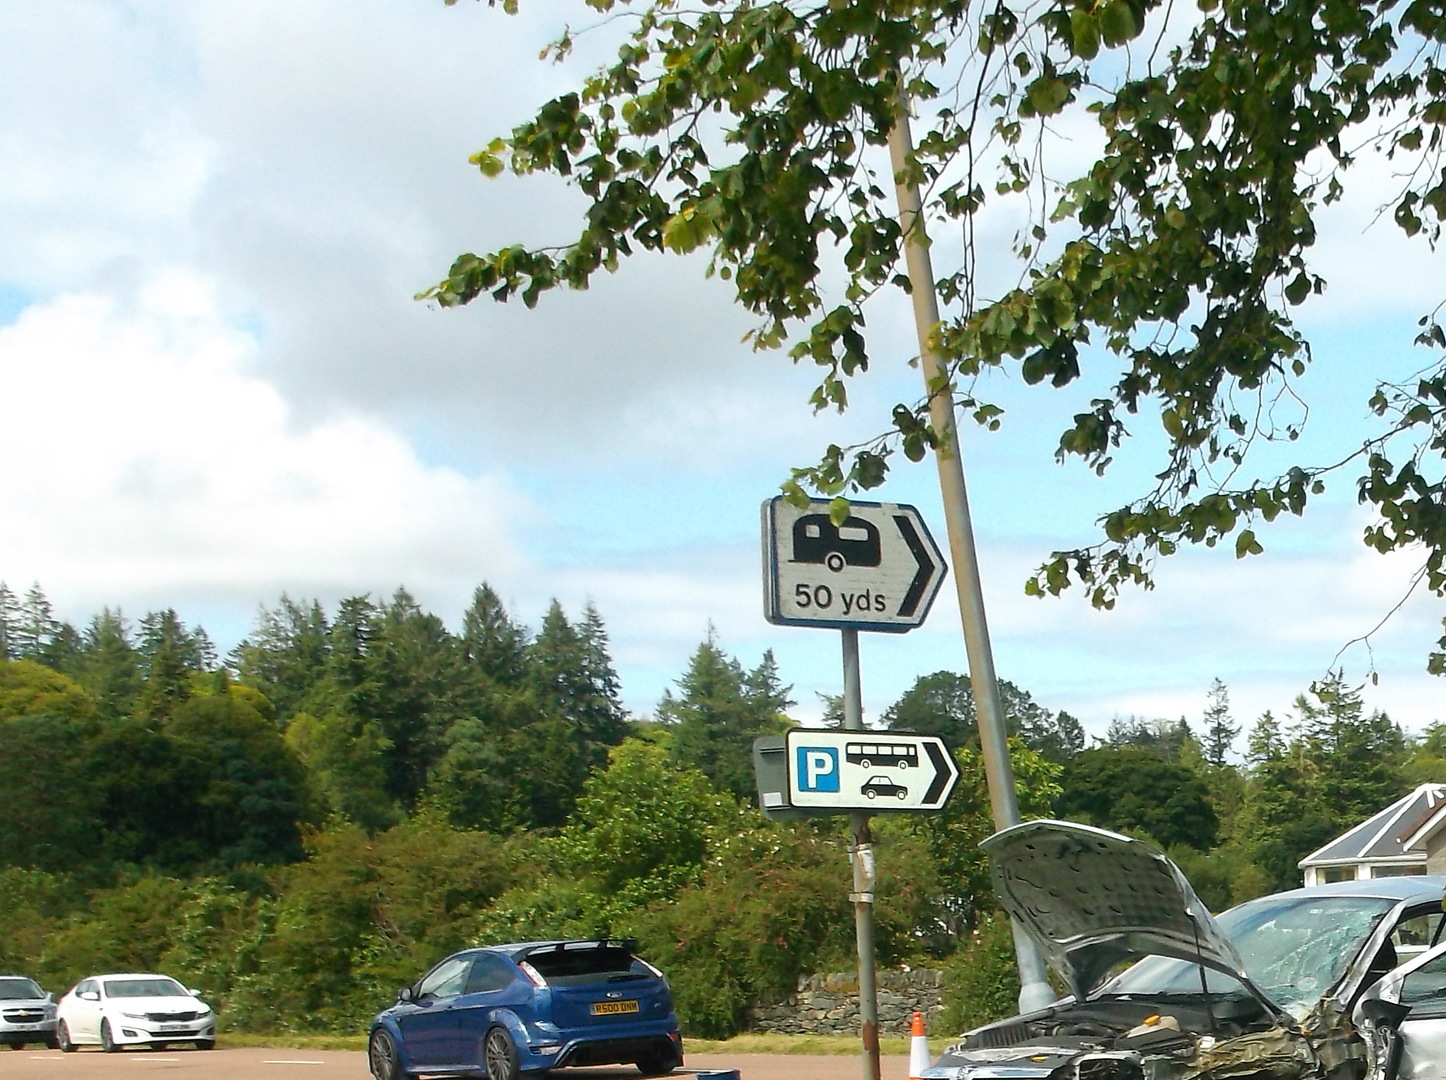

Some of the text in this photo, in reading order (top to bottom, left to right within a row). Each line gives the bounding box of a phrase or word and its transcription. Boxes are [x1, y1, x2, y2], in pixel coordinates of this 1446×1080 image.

[795, 583, 887, 615] 50 yds
[806, 751, 834, 789] P
